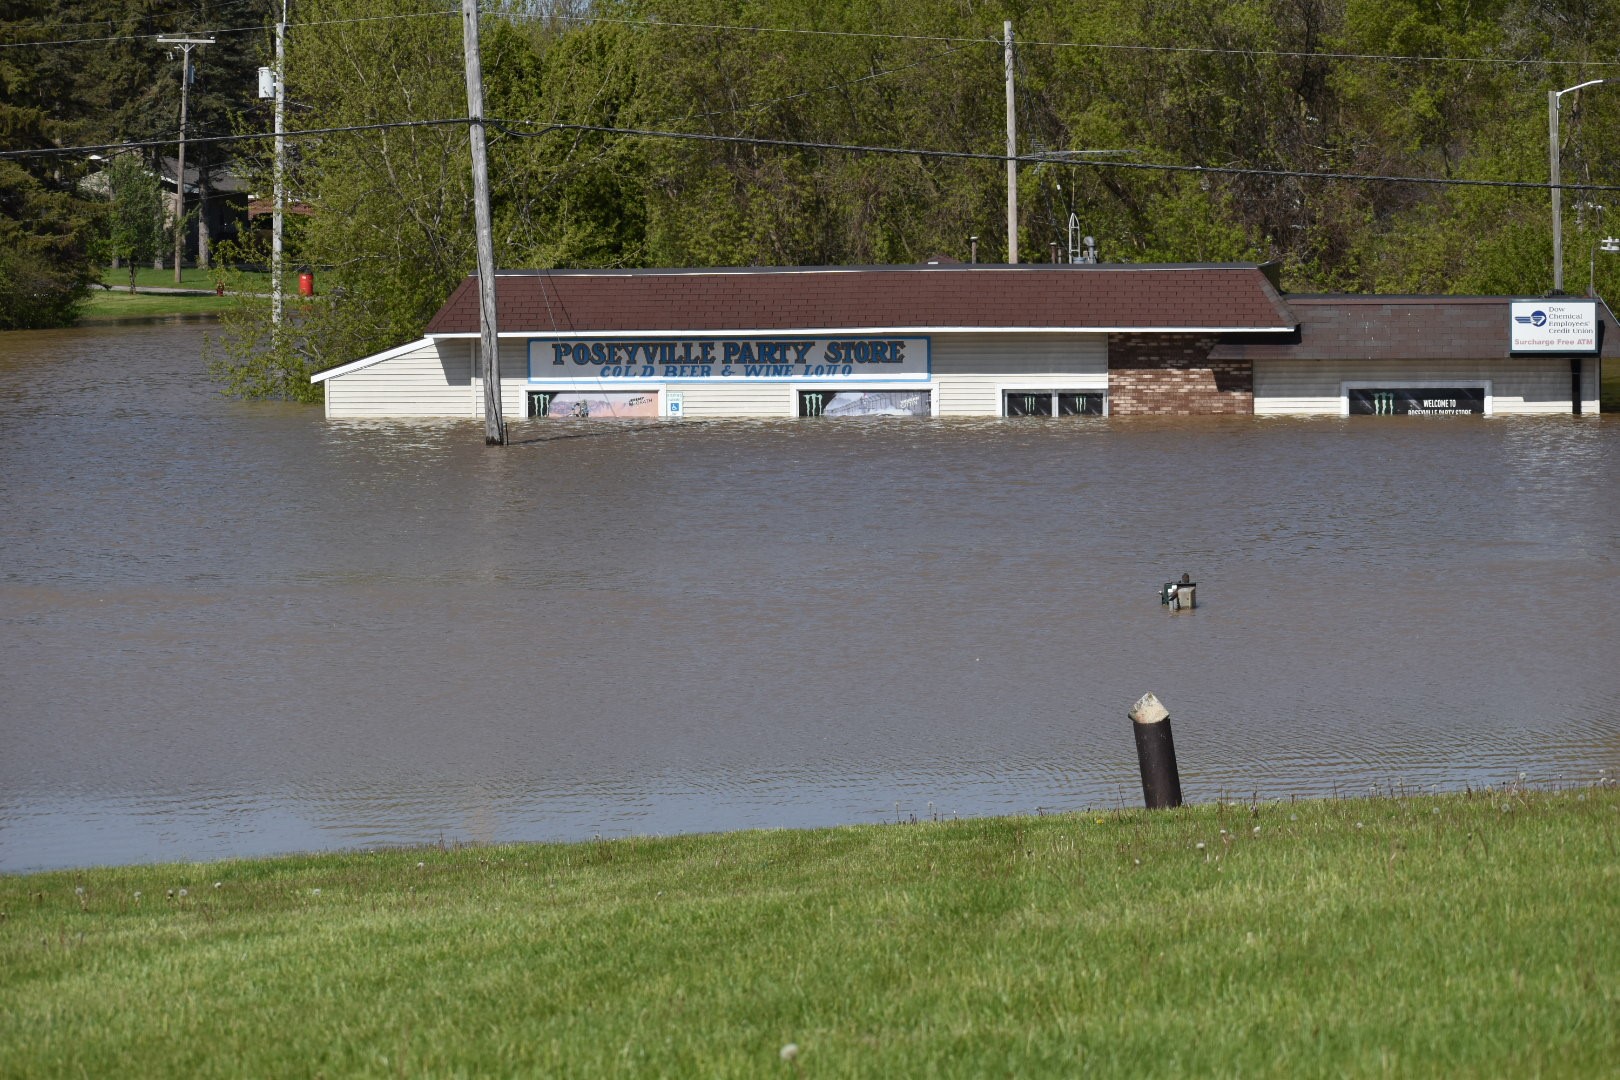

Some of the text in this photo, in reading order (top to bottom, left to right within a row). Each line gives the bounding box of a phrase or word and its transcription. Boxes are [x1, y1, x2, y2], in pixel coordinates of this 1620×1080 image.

[1514, 338, 1555, 346] Surcharge
[552, 340, 906, 366] POSEYVILLE PARTY STORE
[600, 364, 853, 378] COLD BEER & WINE LOTTO
[1423, 399, 1457, 408] WELCOME TO
